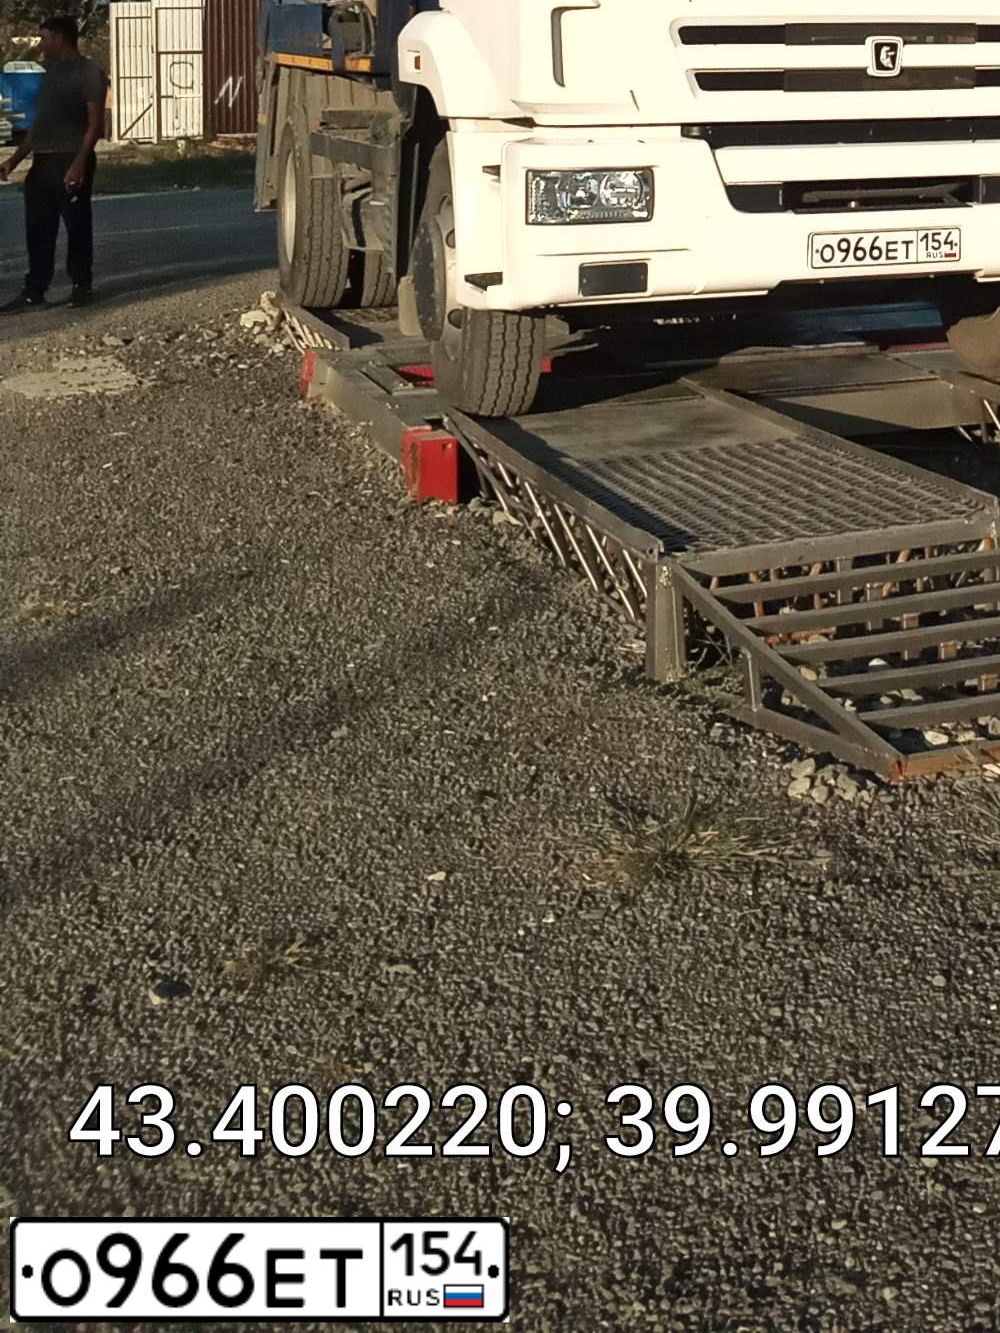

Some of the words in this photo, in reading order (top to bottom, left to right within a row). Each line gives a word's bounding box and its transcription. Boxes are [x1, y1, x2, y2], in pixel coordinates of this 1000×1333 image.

[820, 236, 914, 264] О966ЕТ
[920, 231, 954, 252] 154
[926, 251, 944, 259] RUS
